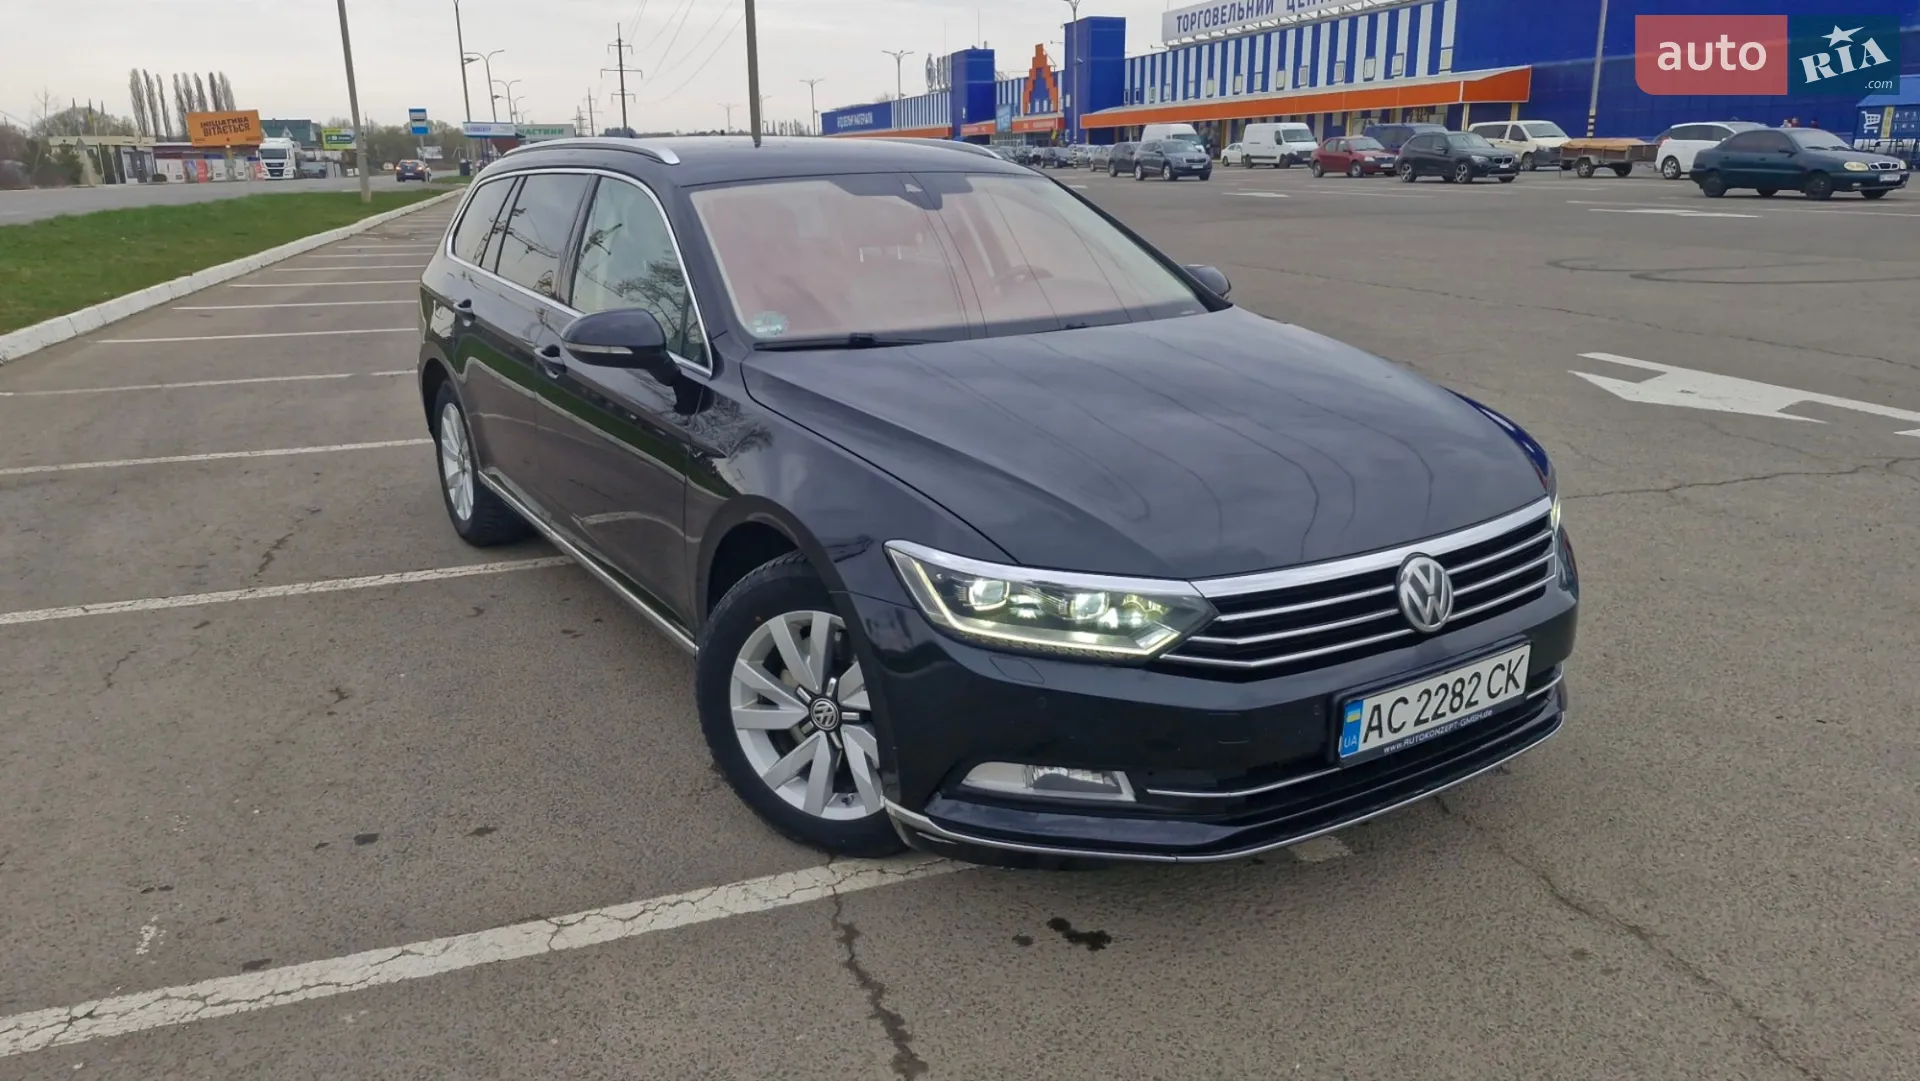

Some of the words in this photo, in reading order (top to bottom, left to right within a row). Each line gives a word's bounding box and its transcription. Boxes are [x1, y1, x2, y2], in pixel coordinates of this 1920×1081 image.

[1362, 696, 1409, 744] AC
[1413, 671, 1482, 727] 2282
[1486, 654, 1525, 699] CK
[1344, 733, 1358, 749] UA
